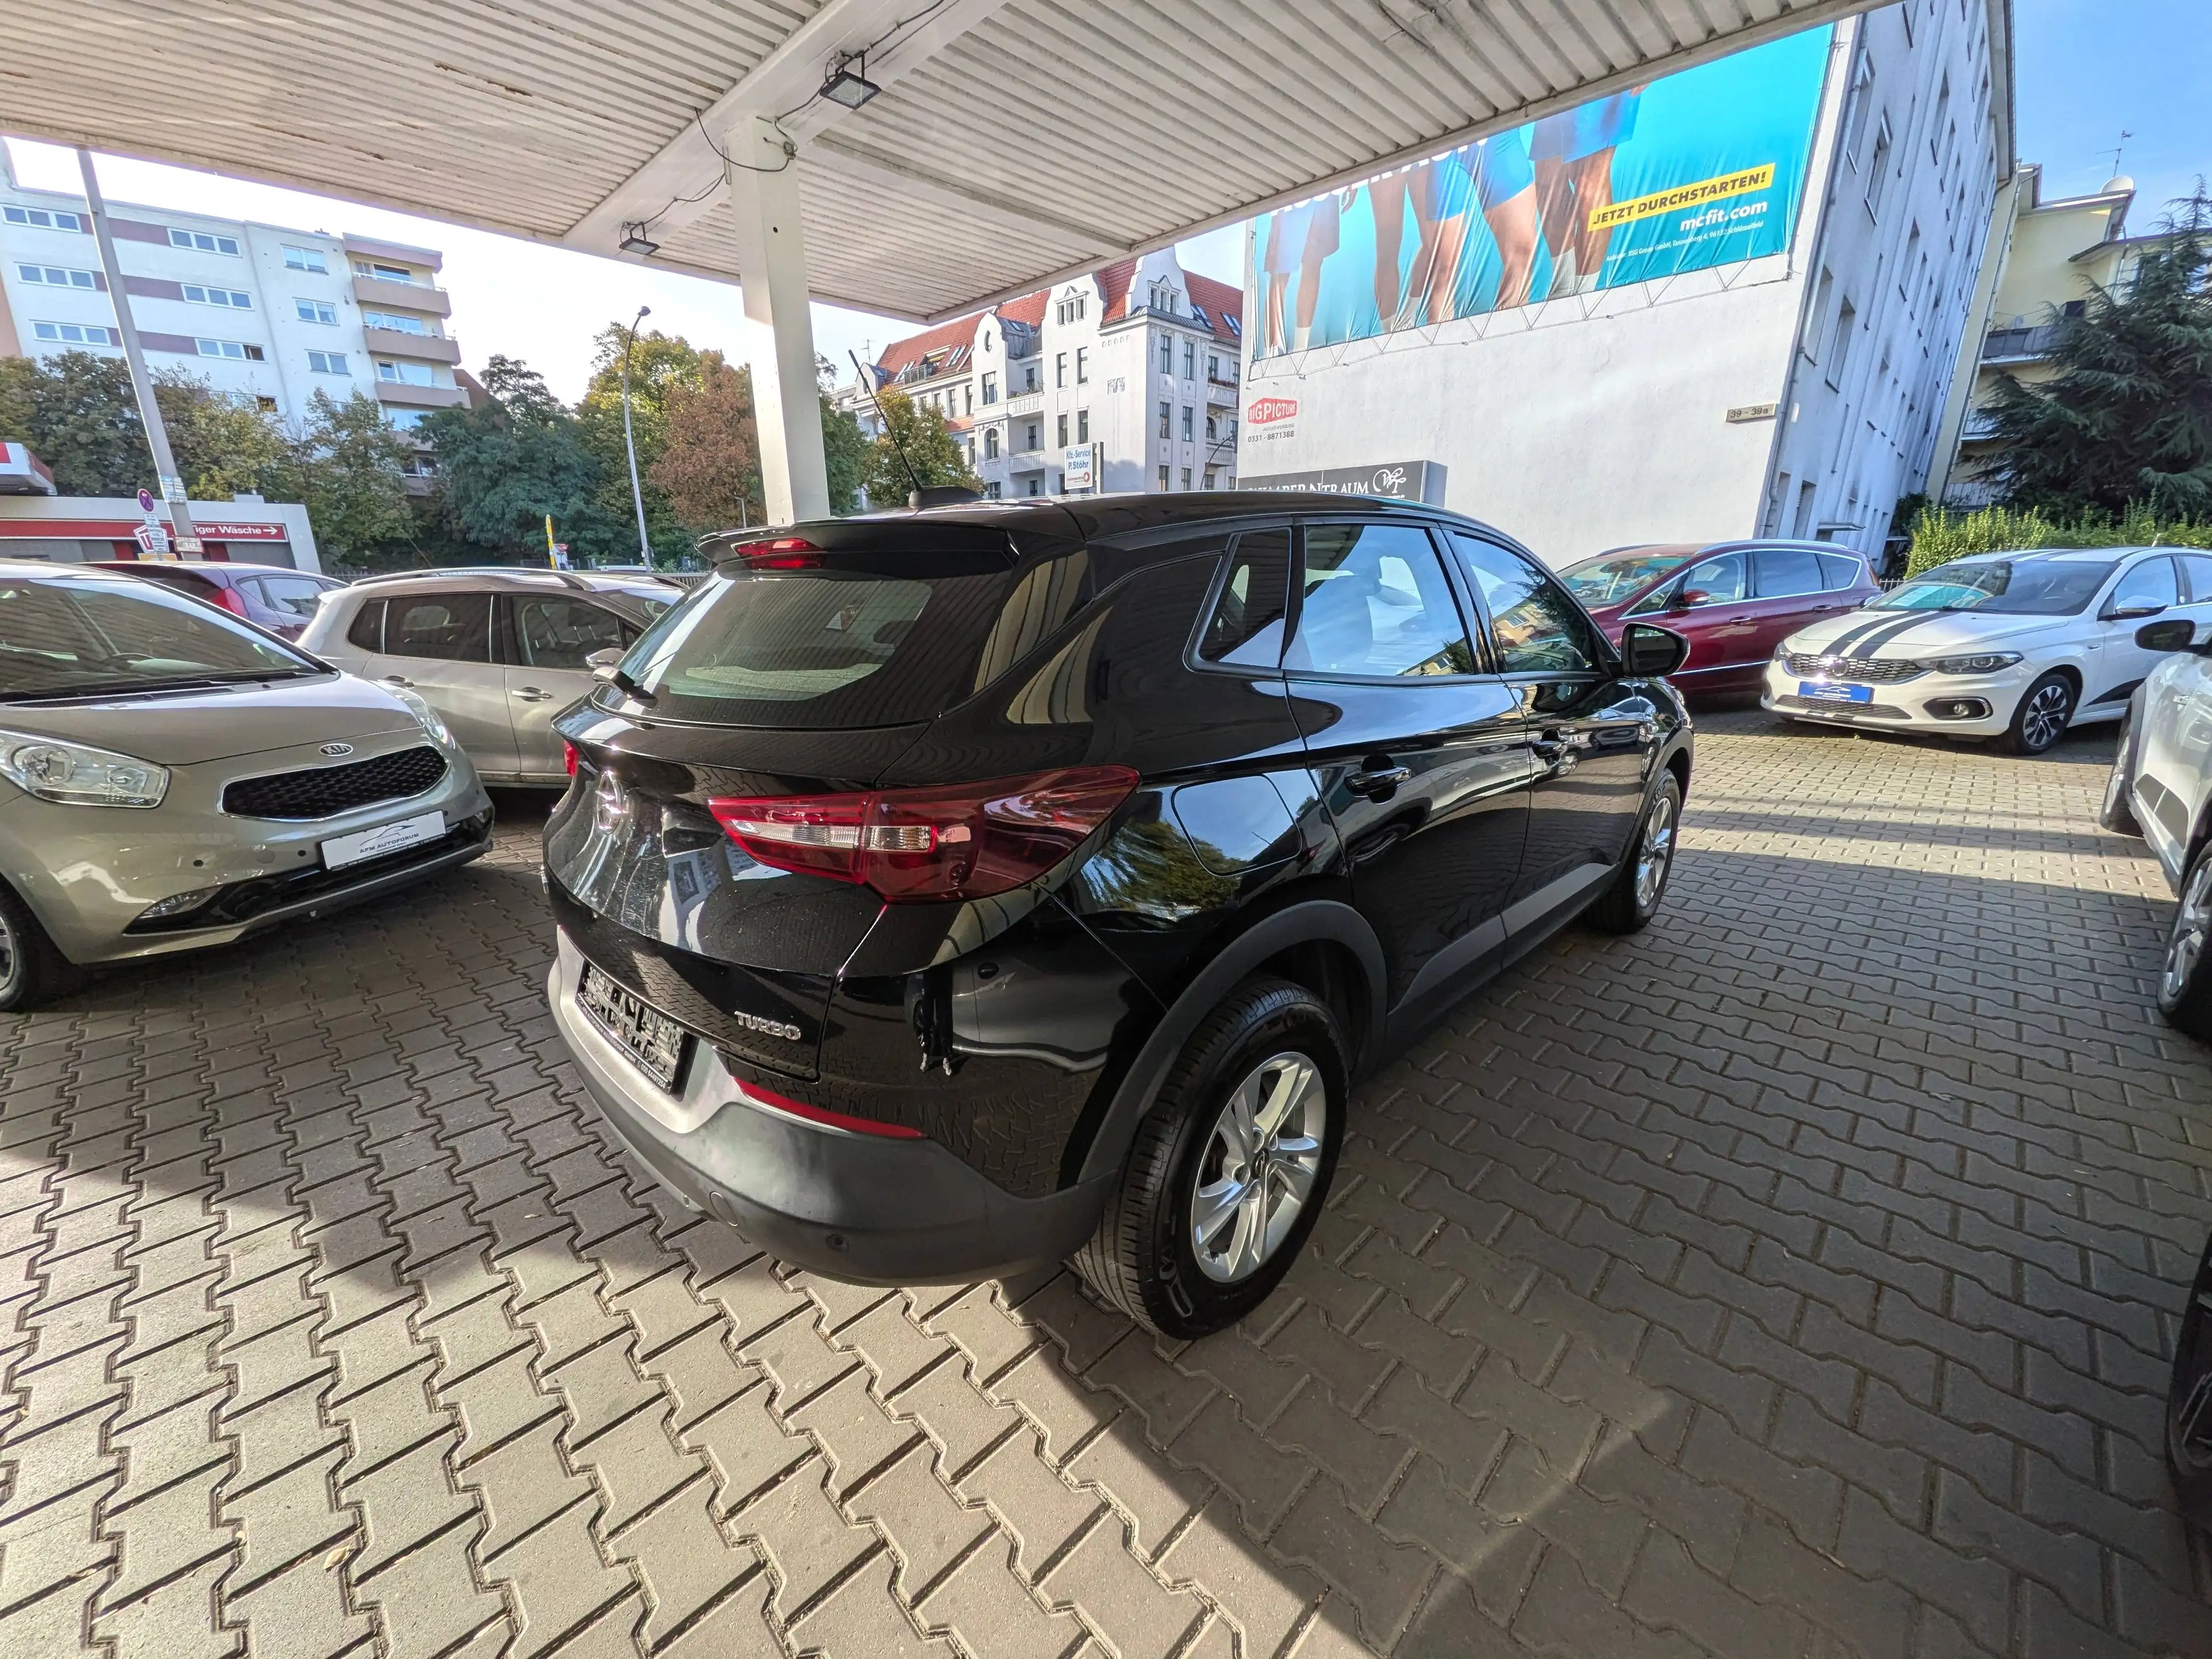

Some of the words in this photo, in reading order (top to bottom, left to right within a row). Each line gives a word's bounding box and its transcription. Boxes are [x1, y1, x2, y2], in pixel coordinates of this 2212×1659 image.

[1593, 205, 1634, 225] JETZT
[1638, 171, 1767, 214] DURCHSTARTEN!
[1680, 202, 1768, 232] mcfit.com
[1628, 248, 1638, 257] RSG
[1638, 245, 1654, 255] Group
[1730, 410, 1742, 418] 39
[1751, 407, 1768, 415] 39a
[1267, 430, 1294, 440] 8871388
[1067, 448, 1091, 459] Kfz-Service
[192, 525, 216, 535] iger
[218, 525, 262, 535] Wäsche
[323, 744, 351, 755] KIA
[359, 845, 376, 853] AFM
[377, 833, 419, 849] AUTOFORUM
[734, 1010, 801, 1041] TURBO
